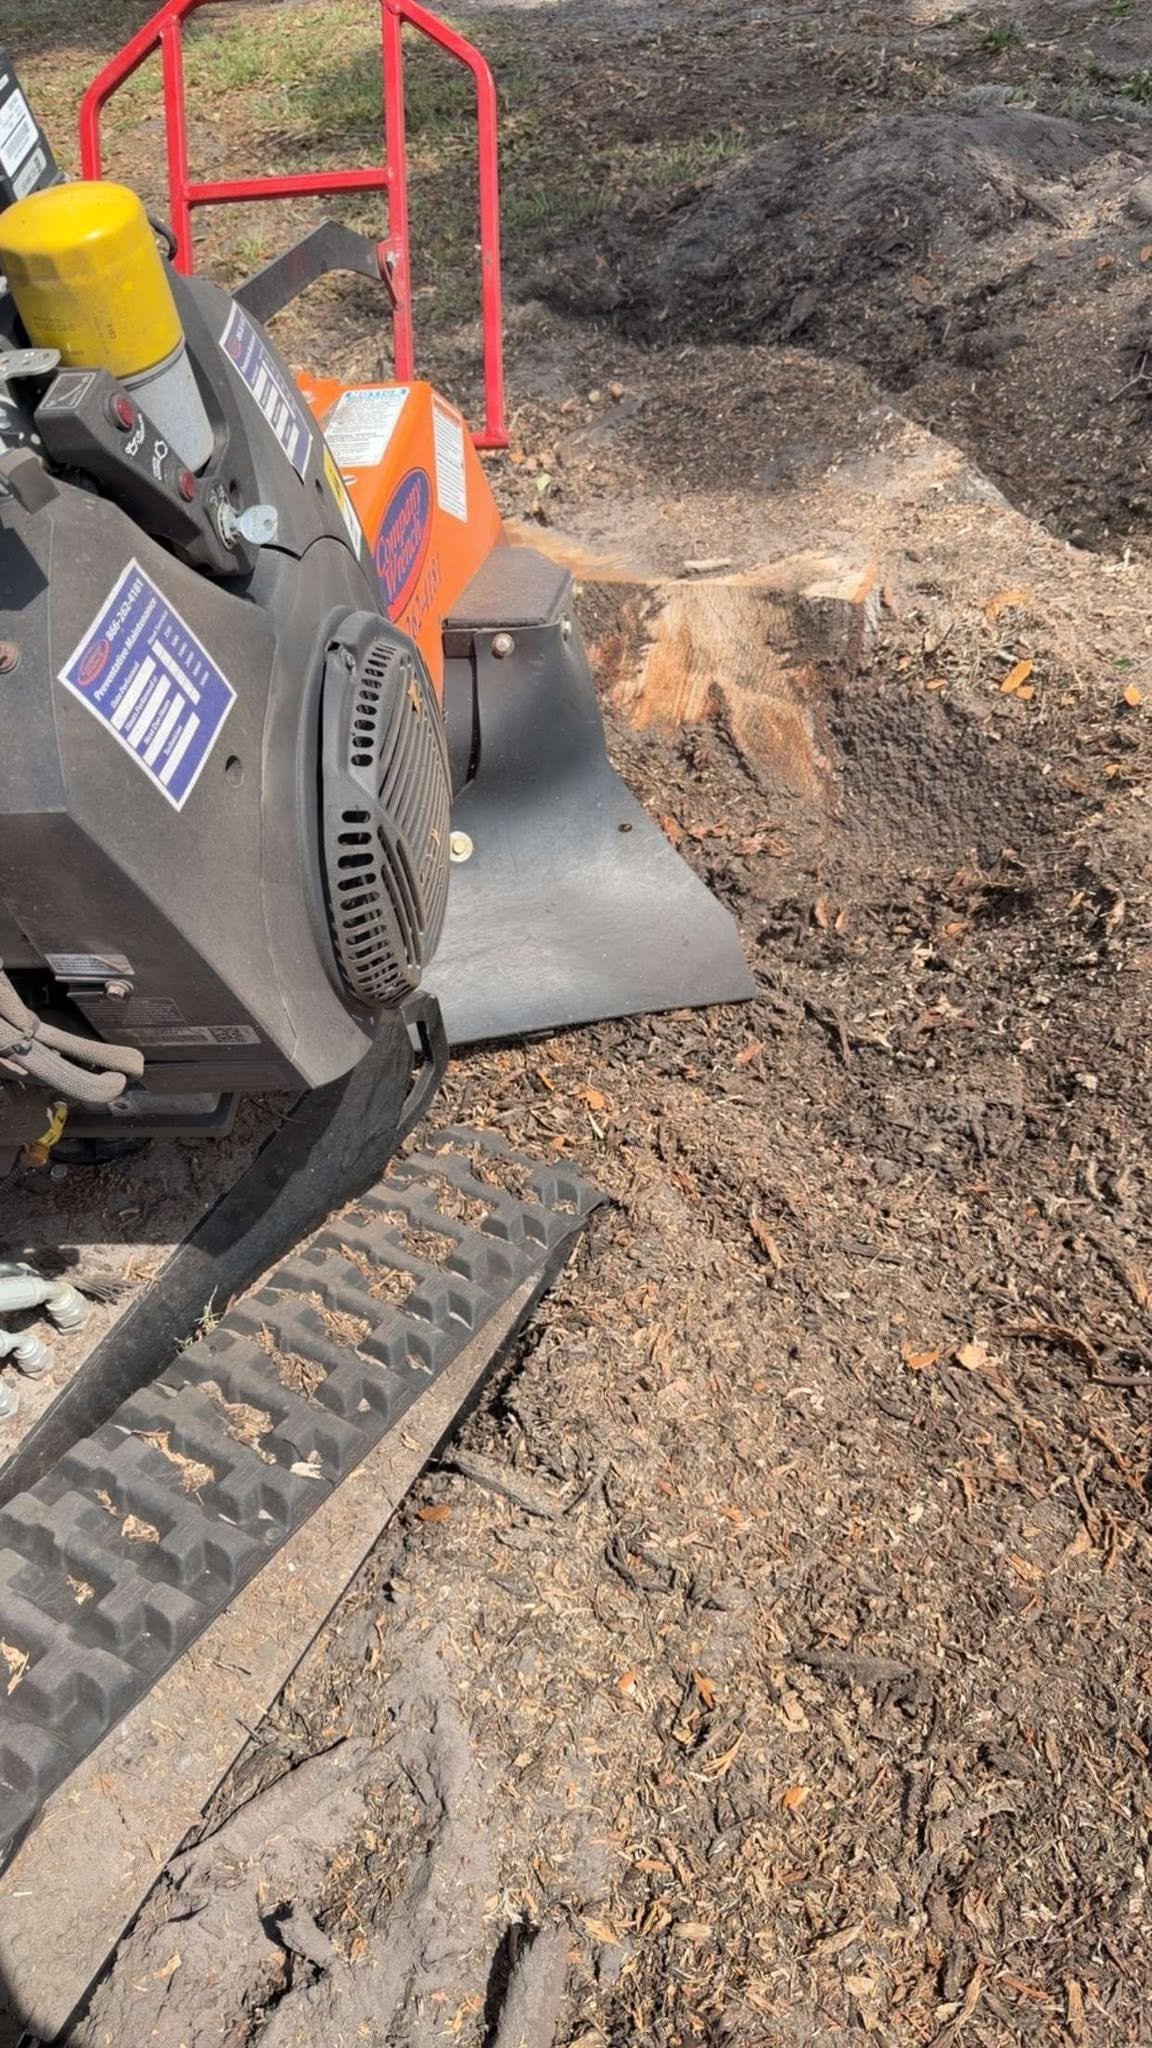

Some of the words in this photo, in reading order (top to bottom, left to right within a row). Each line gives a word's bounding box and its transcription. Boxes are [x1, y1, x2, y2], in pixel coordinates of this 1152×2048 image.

[94, 647, 129, 702] Preventative
[124, 597, 158, 651] Maintenance
[104, 578, 144, 642] 866-262-4181
